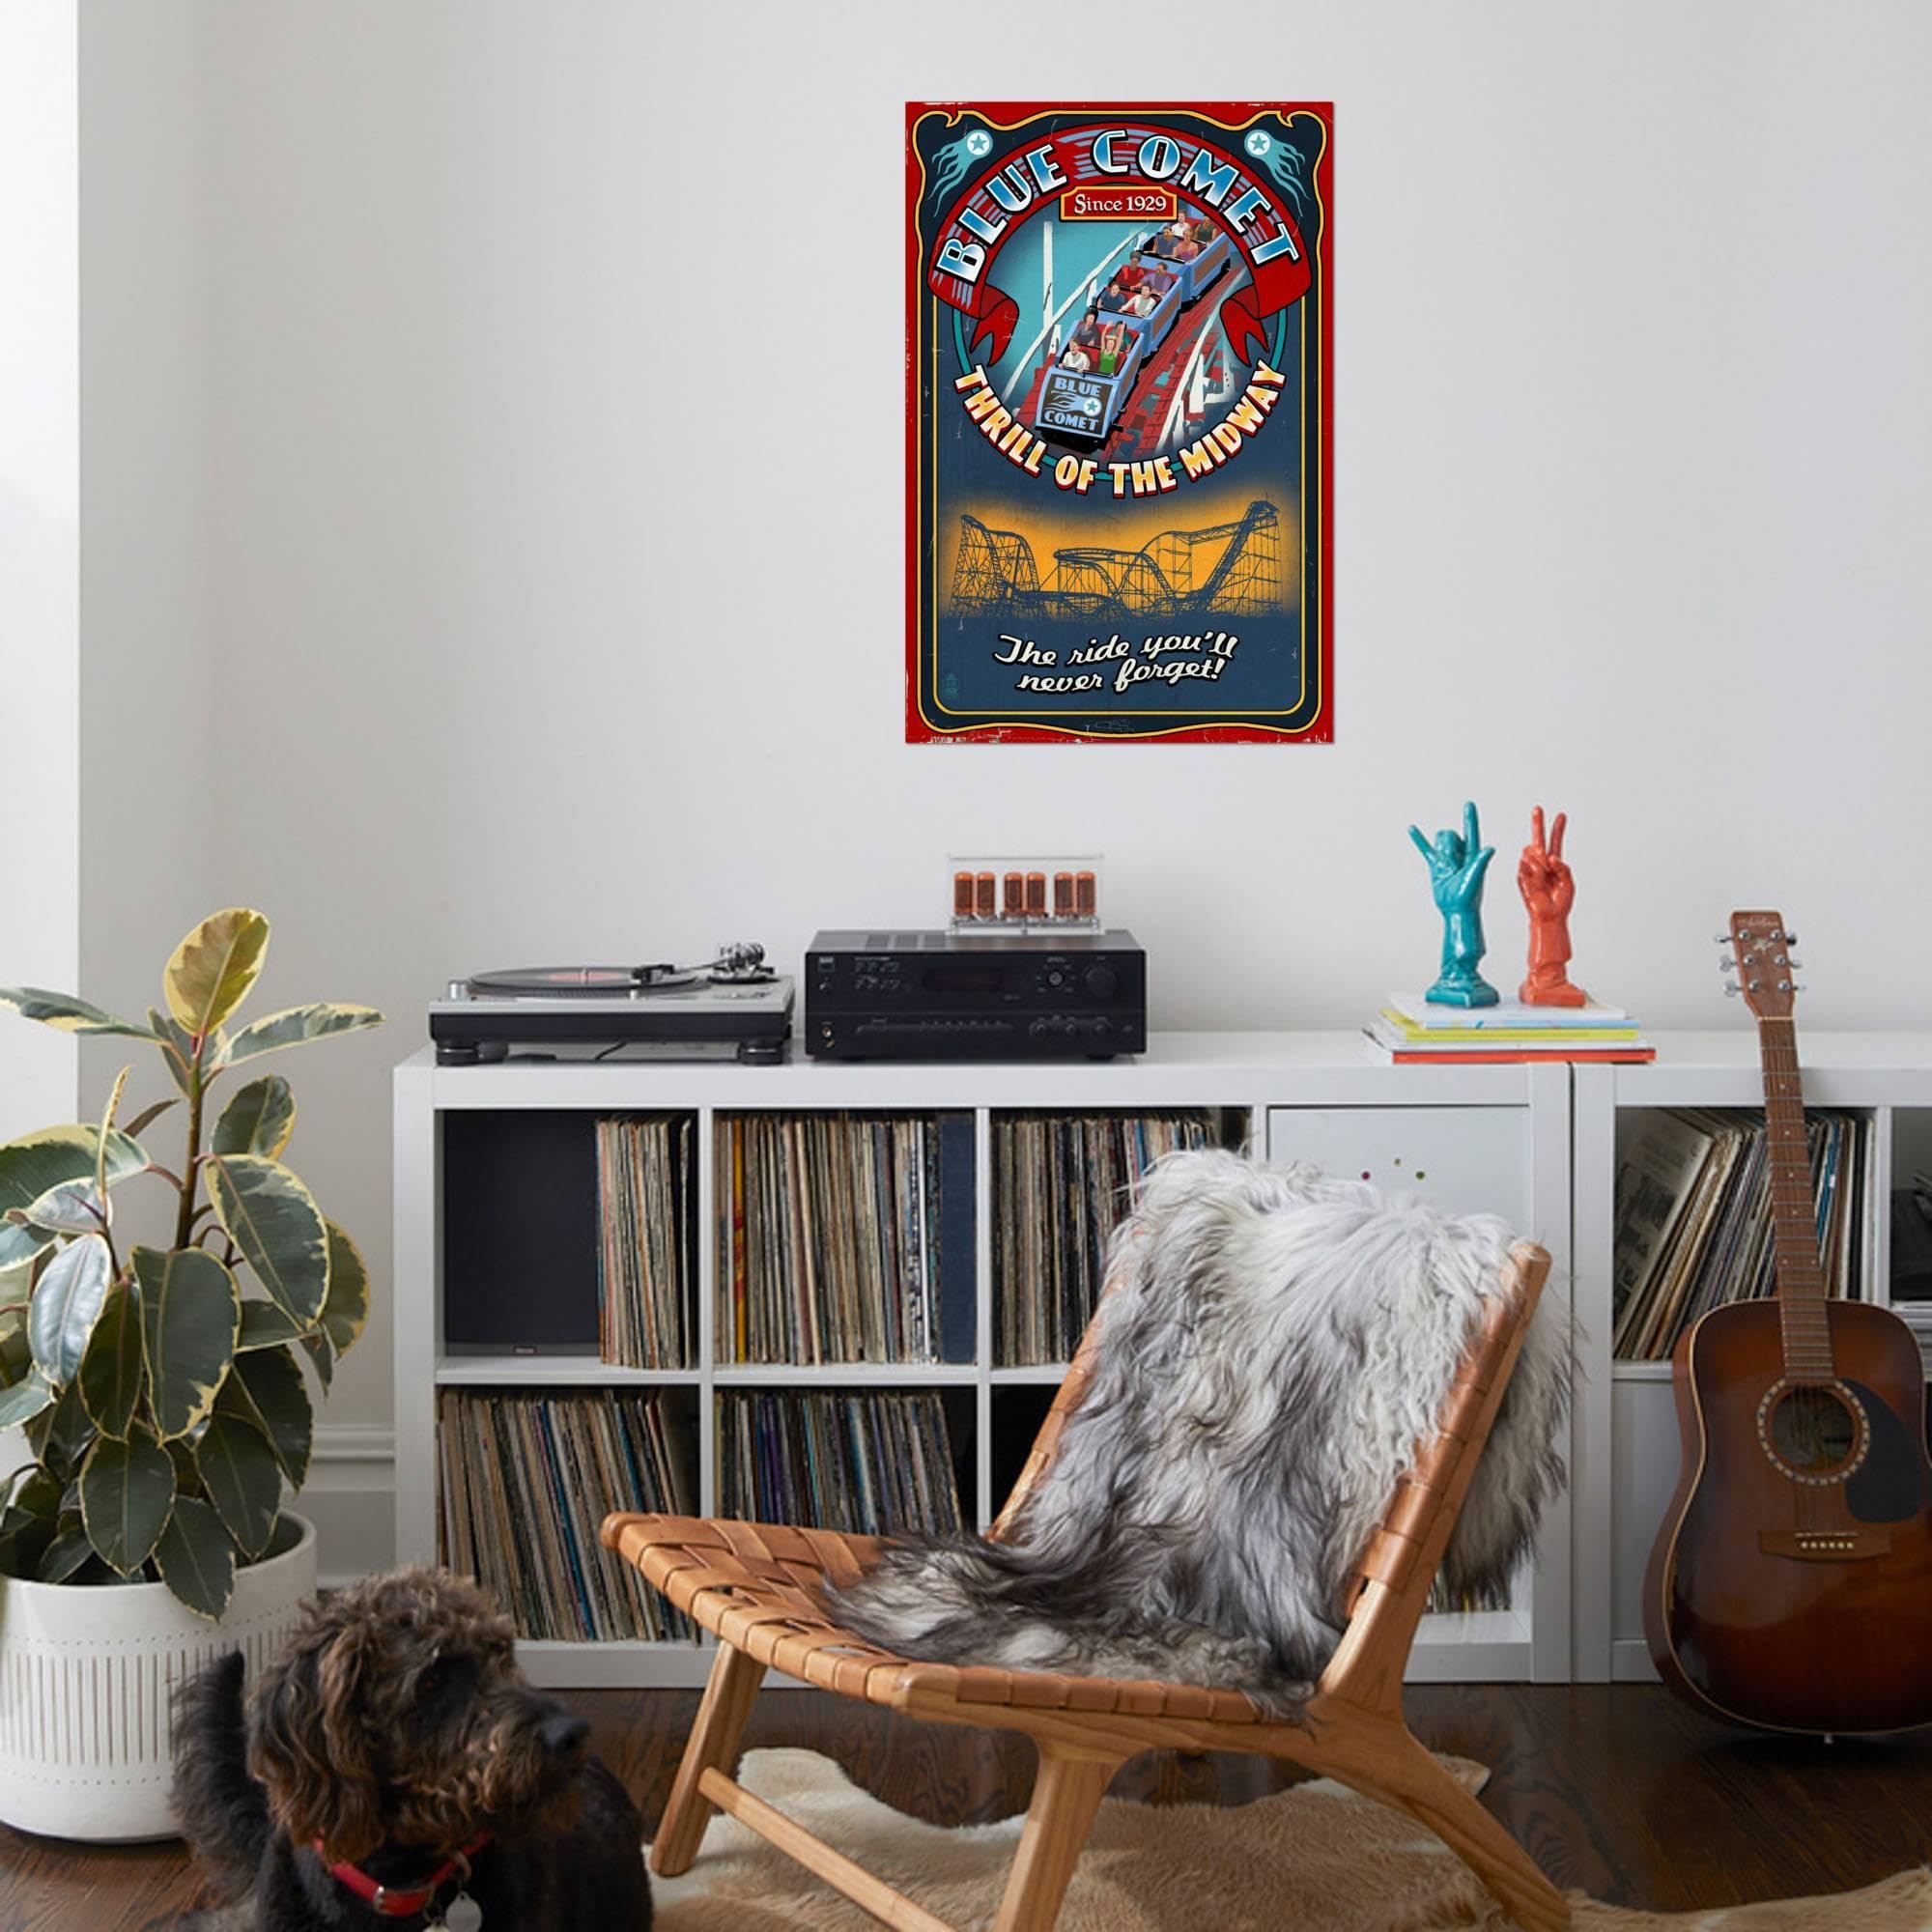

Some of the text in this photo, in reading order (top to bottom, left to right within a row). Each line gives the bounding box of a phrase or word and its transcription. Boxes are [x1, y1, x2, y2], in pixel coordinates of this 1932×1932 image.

[934, 128, 1300, 284] BLUE COMET
[1073, 193, 1167, 214] Since 1929
[1054, 377, 1101, 397] BLUE
[953, 359, 1287, 498] THRILL OF THE MIDWAY
[1043, 410, 1099, 432] COMET
[993, 634, 1058, 667] The
[1065, 634, 1130, 666] ride
[1015, 657, 1226, 693] never forget!
